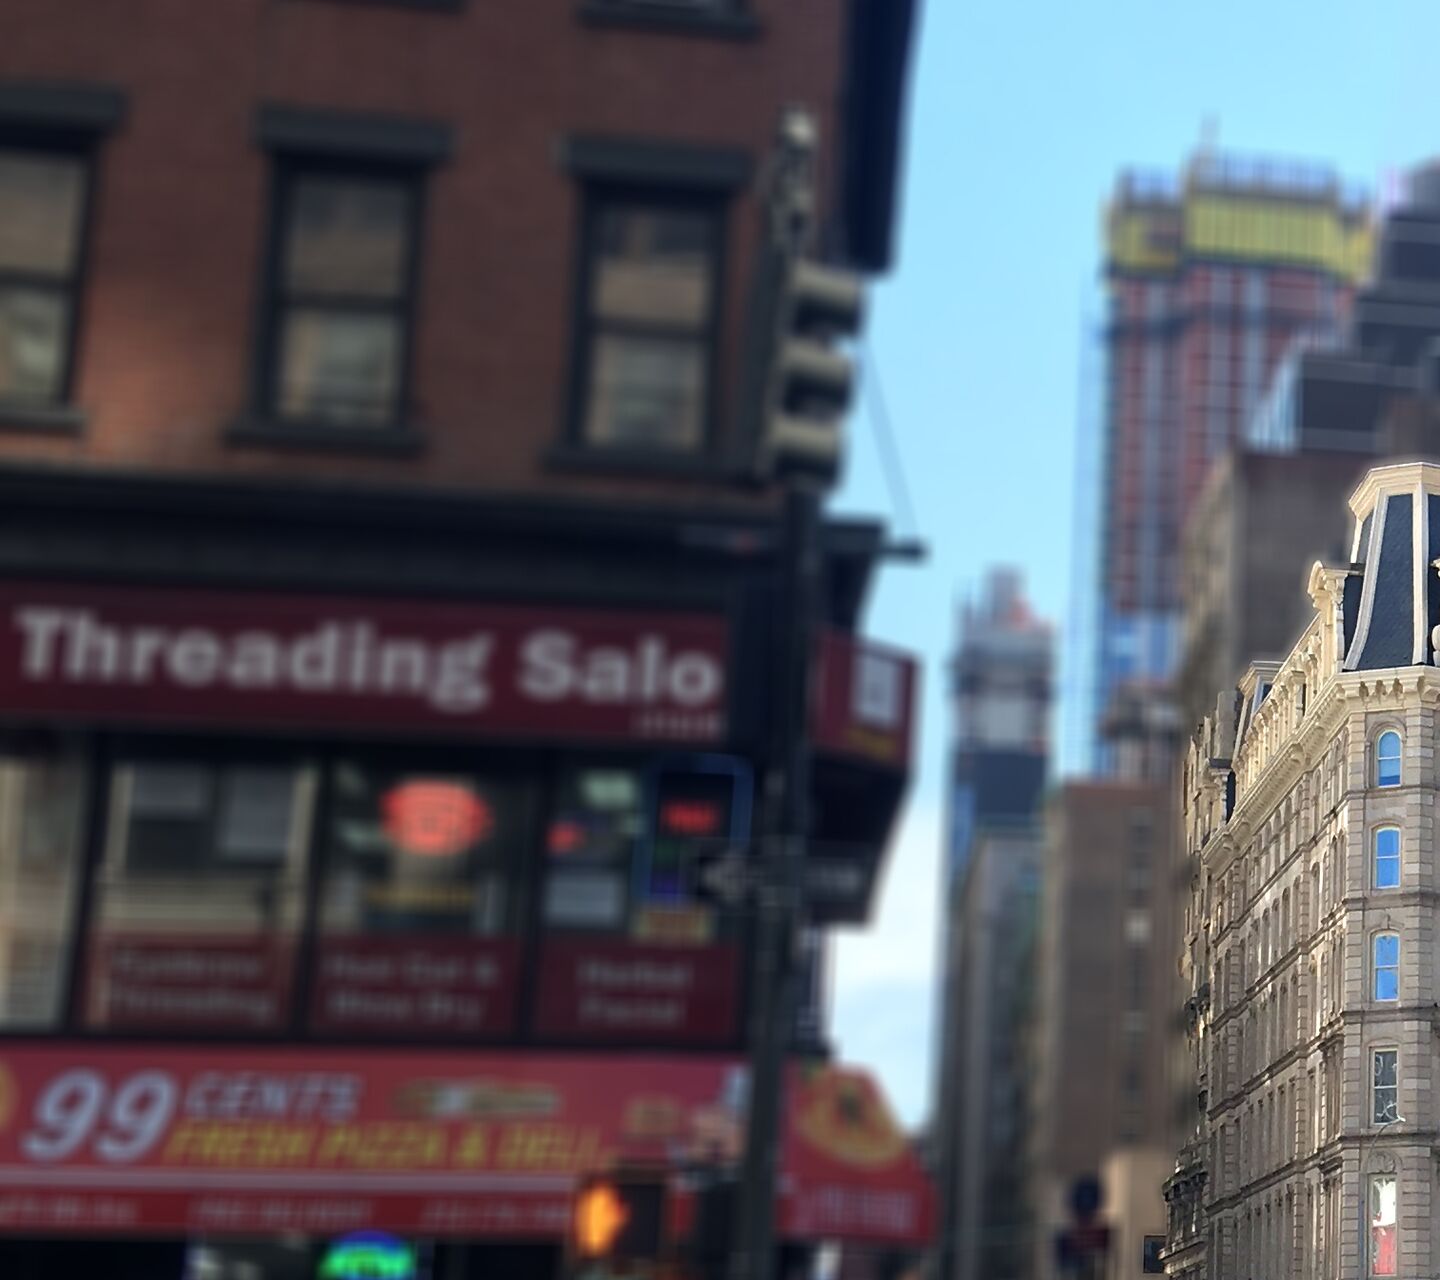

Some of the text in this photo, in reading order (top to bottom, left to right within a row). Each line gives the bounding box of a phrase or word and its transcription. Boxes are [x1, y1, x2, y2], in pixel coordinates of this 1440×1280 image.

[17, 606, 723, 714] Threading Salo
[21, 1069, 178, 1163] 99
[185, 1072, 362, 1118] CENTS
[166, 1124, 312, 1166] FRESH
[318, 1125, 444, 1168] PIZZA
